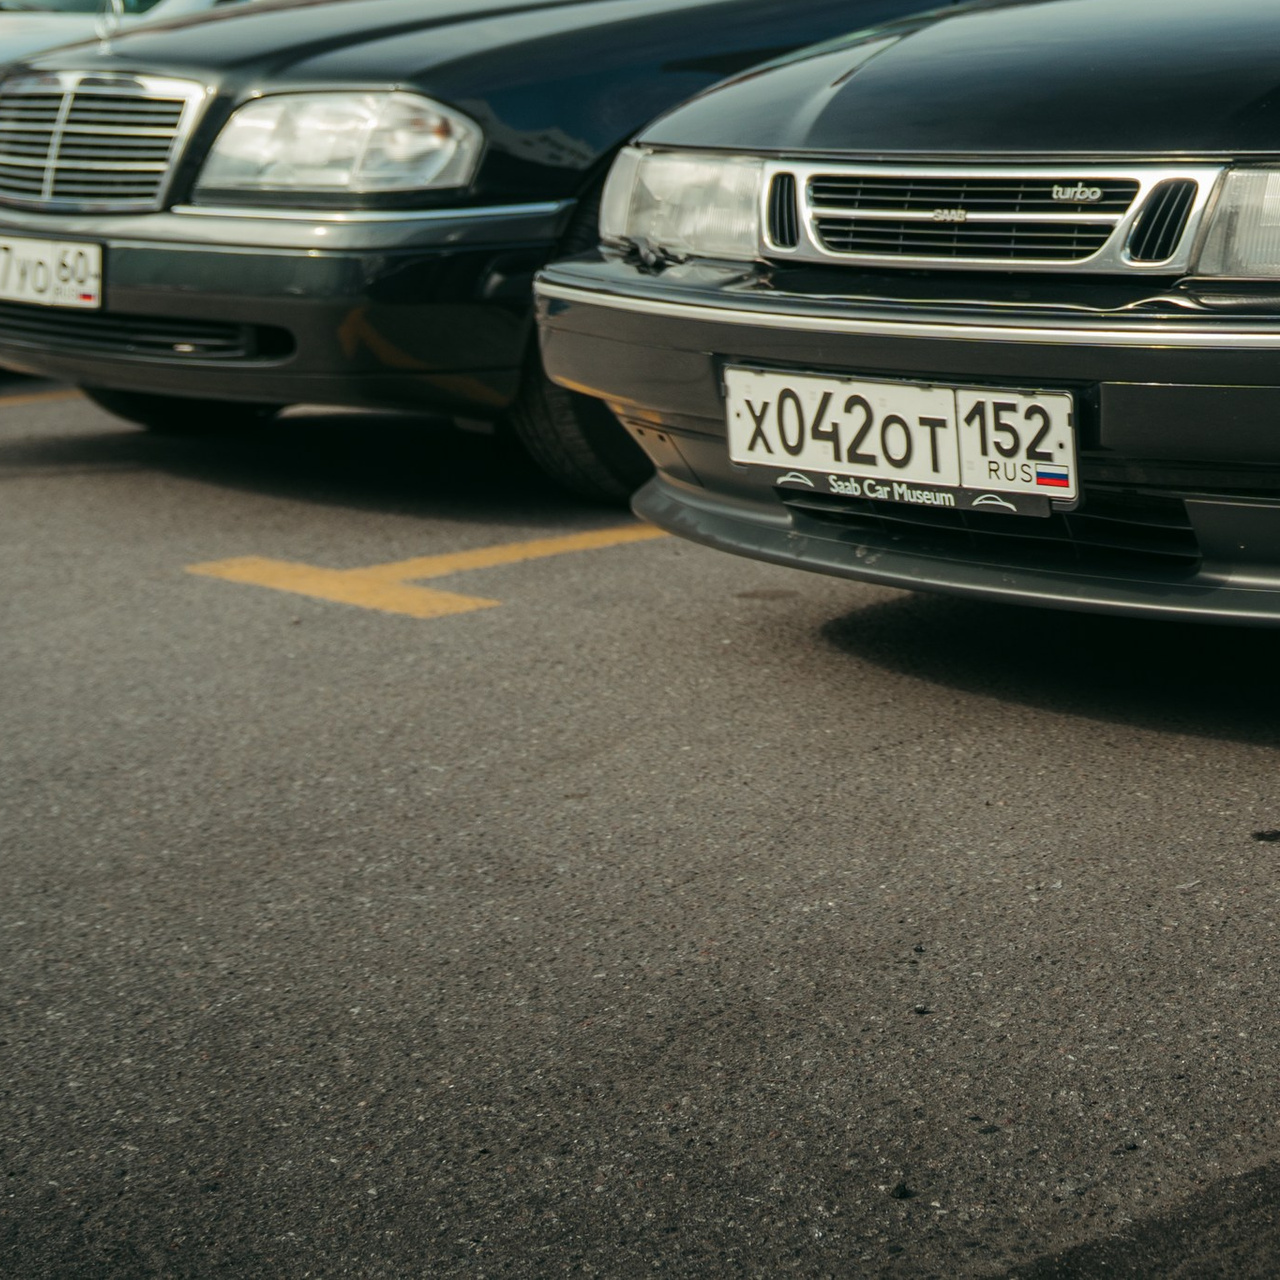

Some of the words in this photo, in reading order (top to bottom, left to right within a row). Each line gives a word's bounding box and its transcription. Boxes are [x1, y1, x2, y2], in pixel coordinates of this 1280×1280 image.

[1052, 182, 1101, 202] turbo
[933, 209, 967, 222] SAAB
[964, 400, 1053, 462] 152
[988, 460, 1033, 483] RUS
[828, 475, 861, 497] Saab
[863, 478, 891, 501] Car
[893, 484, 955, 507] Museum
